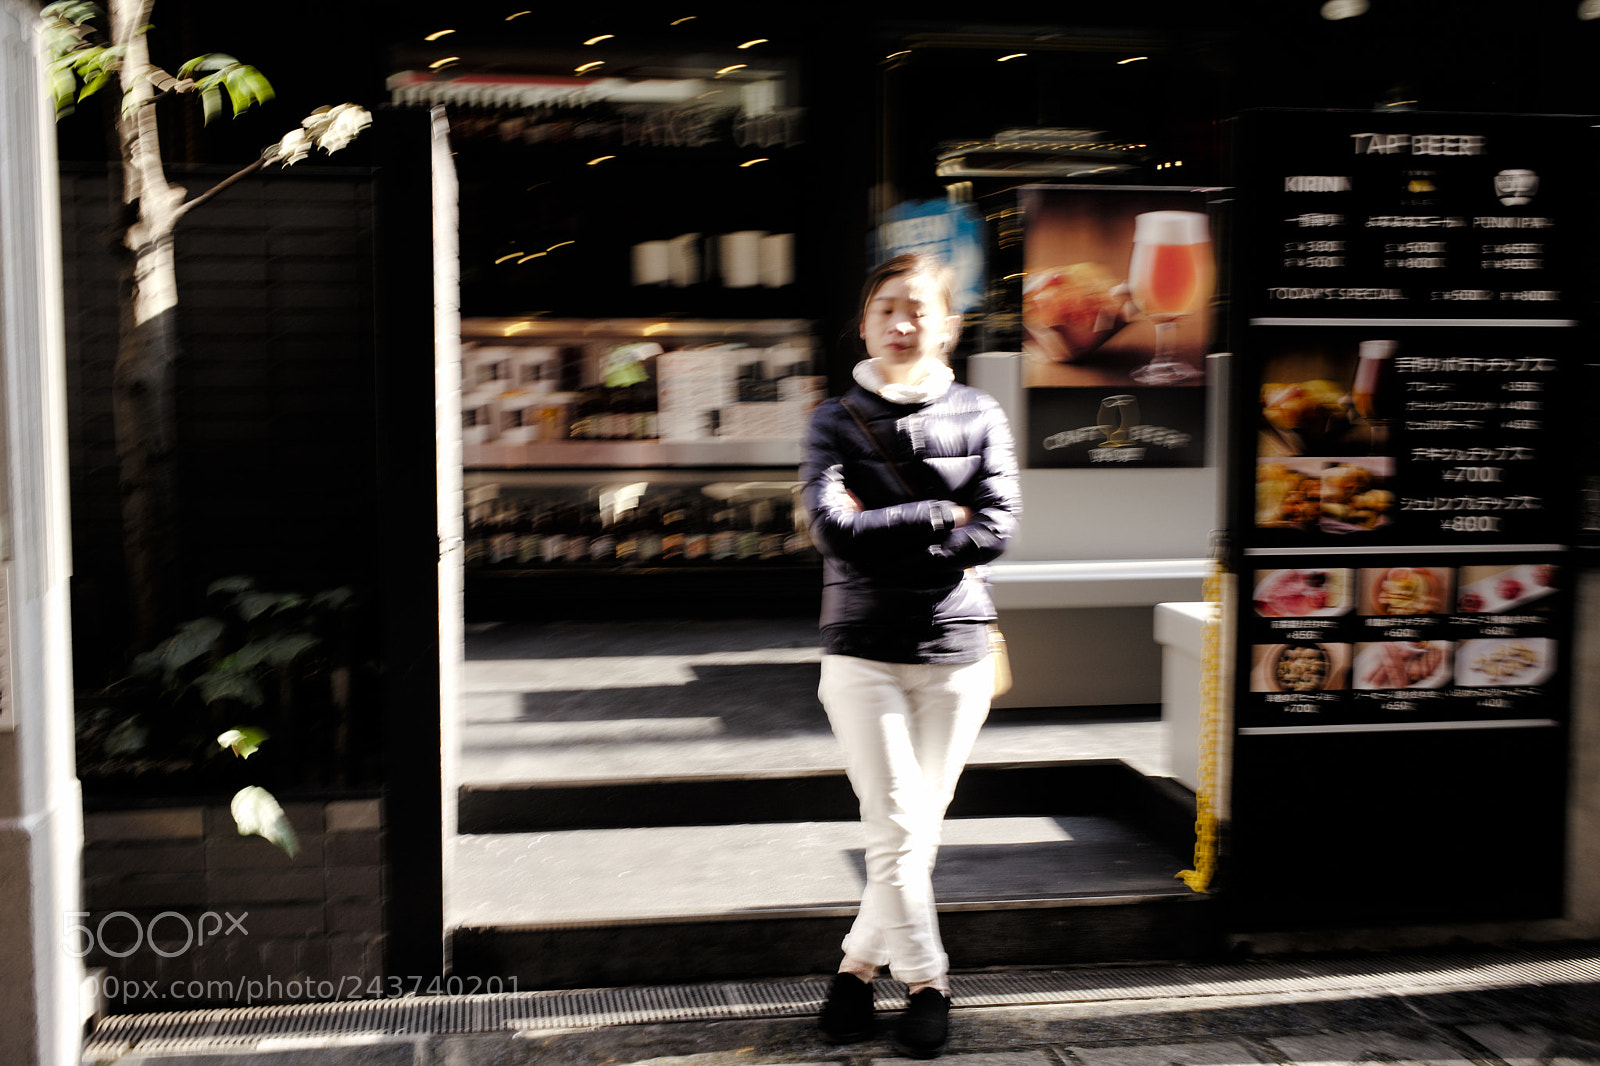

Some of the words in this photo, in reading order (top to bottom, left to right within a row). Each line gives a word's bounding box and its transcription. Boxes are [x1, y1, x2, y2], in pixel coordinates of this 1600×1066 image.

[1351, 132, 1407, 154] TAP
[1411, 134, 1486, 156] BEER
[1284, 175, 1352, 192] KIRIN
[1473, 216, 1516, 229] PUNK
[1516, 216, 1552, 229] IPA
[1267, 287, 1335, 300] TODAY'S
[1337, 287, 1406, 300] SPECIAL
[1441, 466, 1504, 483] ¥700
[1440, 515, 1502, 532] ¥800
